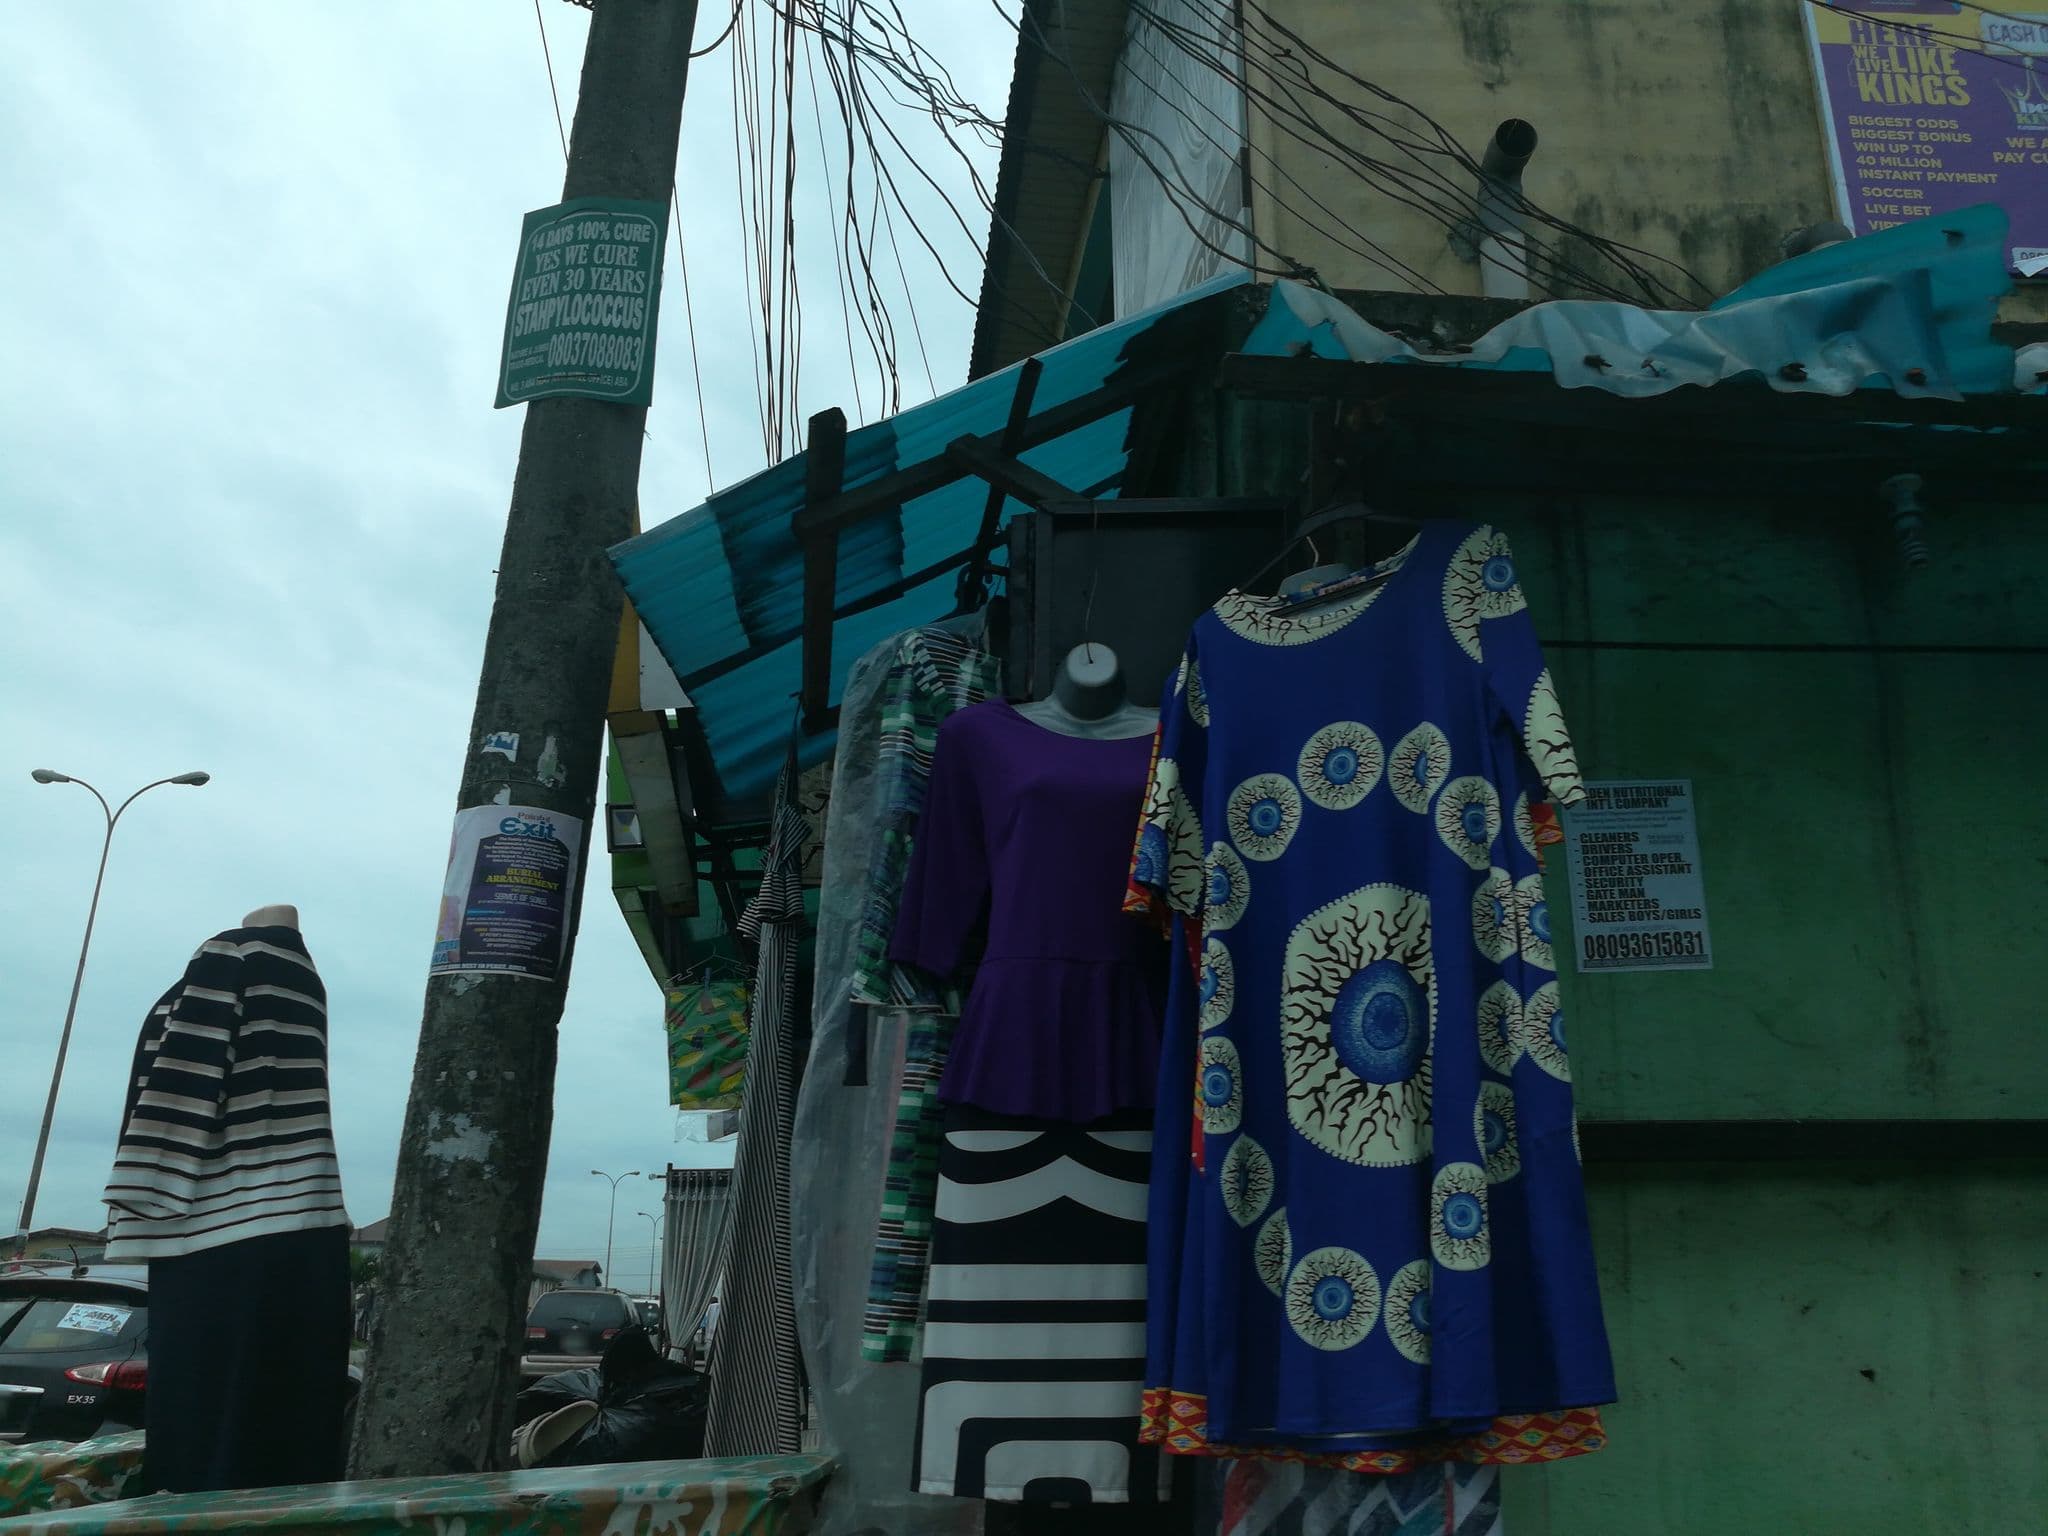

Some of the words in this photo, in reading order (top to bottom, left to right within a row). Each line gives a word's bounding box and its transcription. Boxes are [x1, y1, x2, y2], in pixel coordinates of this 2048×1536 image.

[1849, 20, 1938, 46] HERE
[1989, 23, 2037, 44] CASH
[1852, 45, 1878, 60] WE
[1855, 60, 1889, 73] LIVE
[1888, 46, 1960, 75] LIKE
[1857, 72, 1971, 106] KINGS
[1848, 115, 1912, 127] BIGGEST
[1916, 118, 1959, 129] ODDS
[1852, 129, 1914, 141] BIGGEST
[1919, 131, 1972, 143] BONUS
[1853, 142, 1887, 153] WIN
[1890, 144, 1908, 154] UP
[1913, 145, 1934, 155] TO
[2006, 137, 2037, 149] WE
[1856, 155, 1876, 166] 40
[1880, 157, 1942, 168] MILLION
[1993, 152, 2025, 164] PAY
[1859, 169, 1922, 181] INSTANT
[1927, 172, 1998, 184] PAYMENT
[1862, 187, 1923, 199] SOCCER
[1865, 203, 1899, 215] LIVE
[1903, 205, 1932, 216] BET
[546, 223, 574, 247] DAYS
[577, 221, 610, 241] 100%
[614, 222, 651, 243] CURE
[535, 249, 560, 273] YES
[565, 244, 589, 265] WE
[593, 244, 639, 266] CURE
[521, 271, 561, 302] EVEN
[563, 269, 585, 291] 30
[591, 267, 646, 294] YEARS
[548, 332, 642, 371] 08037088083
[1613, 785, 1685, 798] NUTRITIONAL
[1615, 798, 1669, 809] COMPANY
[499, 816, 556, 839] Exit
[1580, 832, 1640, 844] CLEANERS
[1581, 844, 1633, 855] DRIVERS
[1583, 854, 1649, 866] COMPUTER
[506, 868, 544, 878] BURIAL
[1584, 865, 1624, 877] OFFICE
[1627, 864, 1693, 876] ASSISTANT
[486, 875, 560, 890] ARRANGEMENT
[1585, 877, 1644, 889] SECURITY
[1586, 889, 1616, 899] GATE
[1618, 888, 1645, 899] MAN
[1588, 899, 1660, 911] MARKETERS
[1588, 910, 1625, 923] SALES
[1629, 908, 1701, 922] BOYS/GIRLS
[1584, 931, 1704, 960] 08093615831
[67, 1395, 96, 1404] EX35
